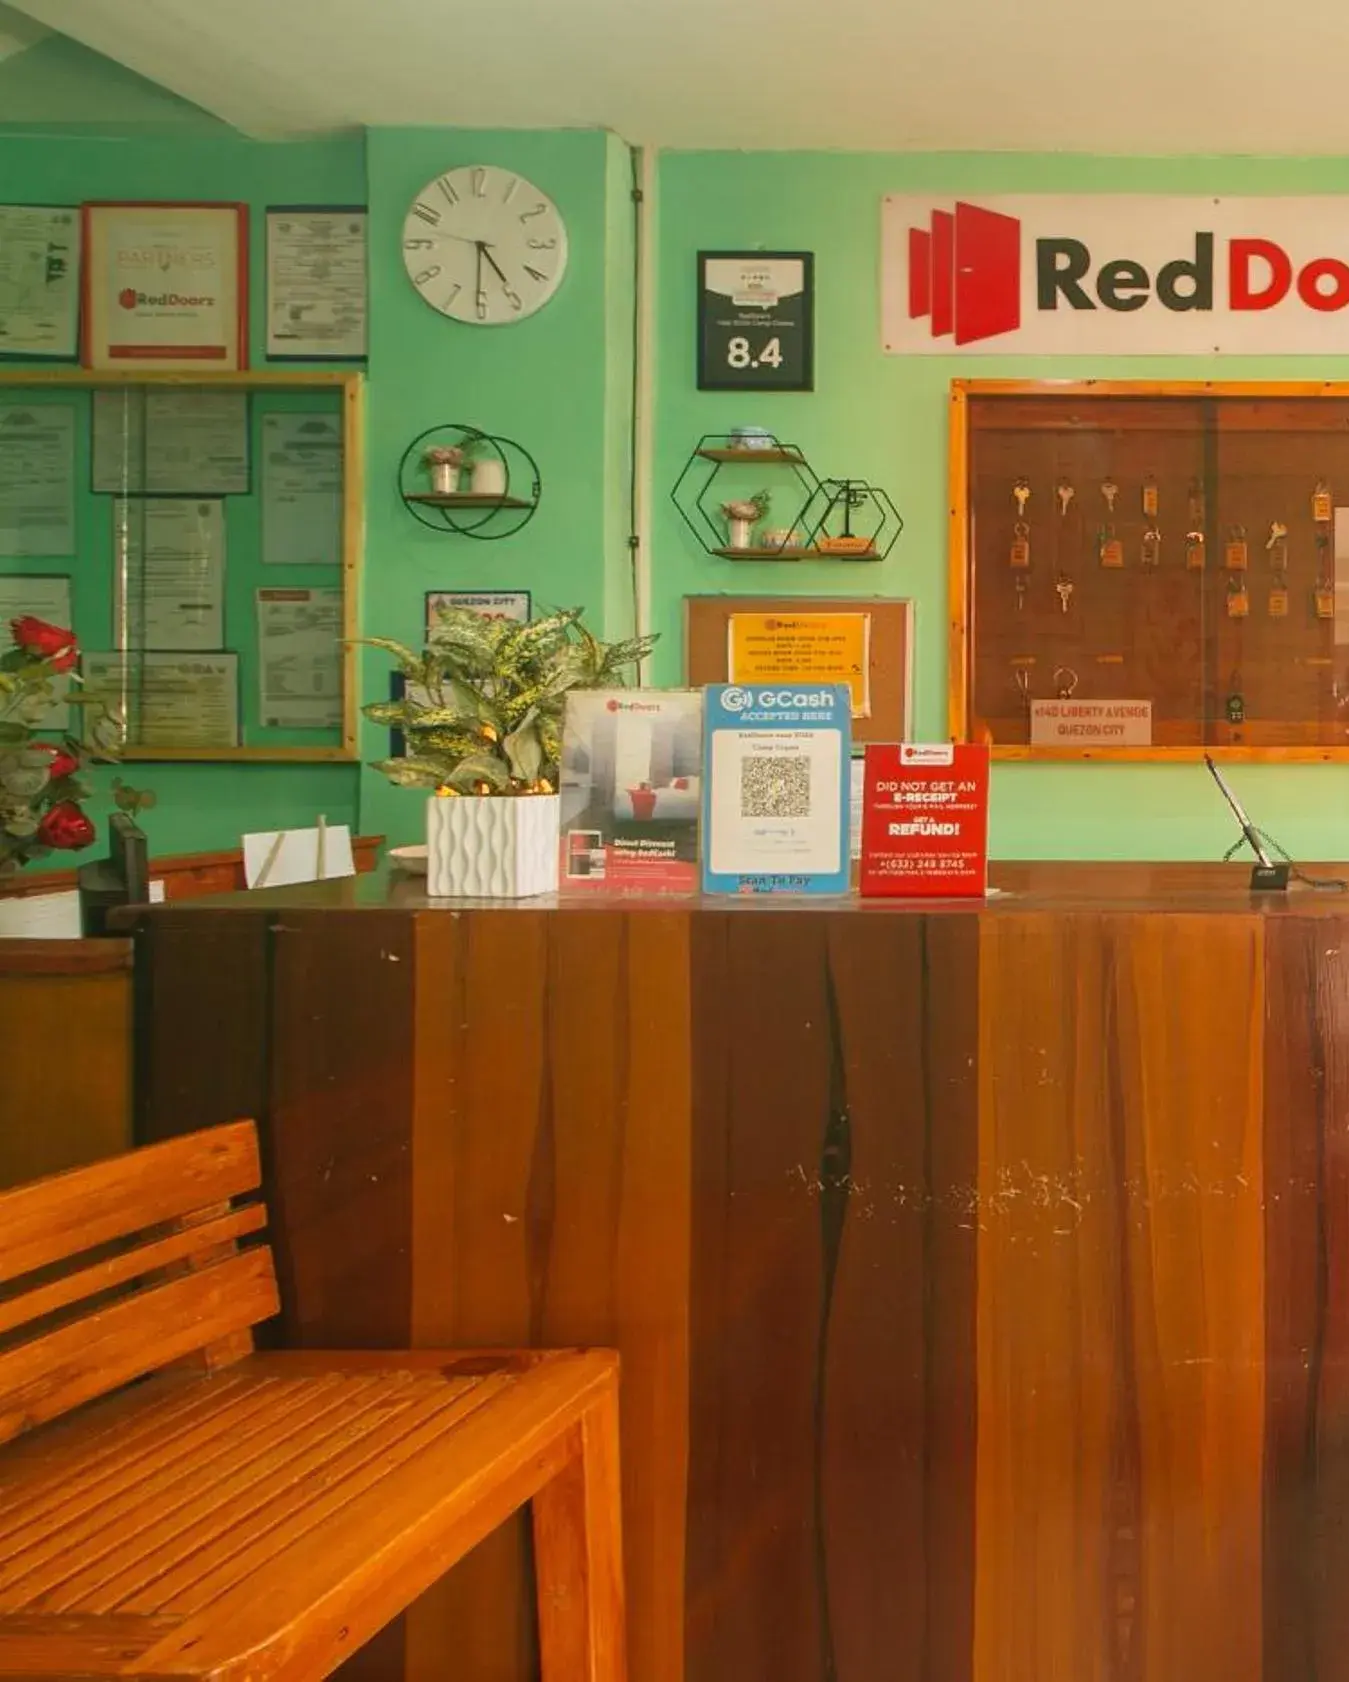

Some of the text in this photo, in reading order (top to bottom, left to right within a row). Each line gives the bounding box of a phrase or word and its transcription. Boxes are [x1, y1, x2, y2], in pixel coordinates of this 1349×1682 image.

[727, 337, 784, 369] 8.4
[758, 690, 835, 708] GCash
[1060, 706, 1103, 718] LIBERTY
[1105, 706, 1150, 719] AVENUE
[1057, 724, 1126, 736] QUEZON CITY
[876, 781, 977, 792] DID NOT GET AN
[893, 792, 958, 803] E-RECEIPT
[888, 823, 961, 836] REFUND!
